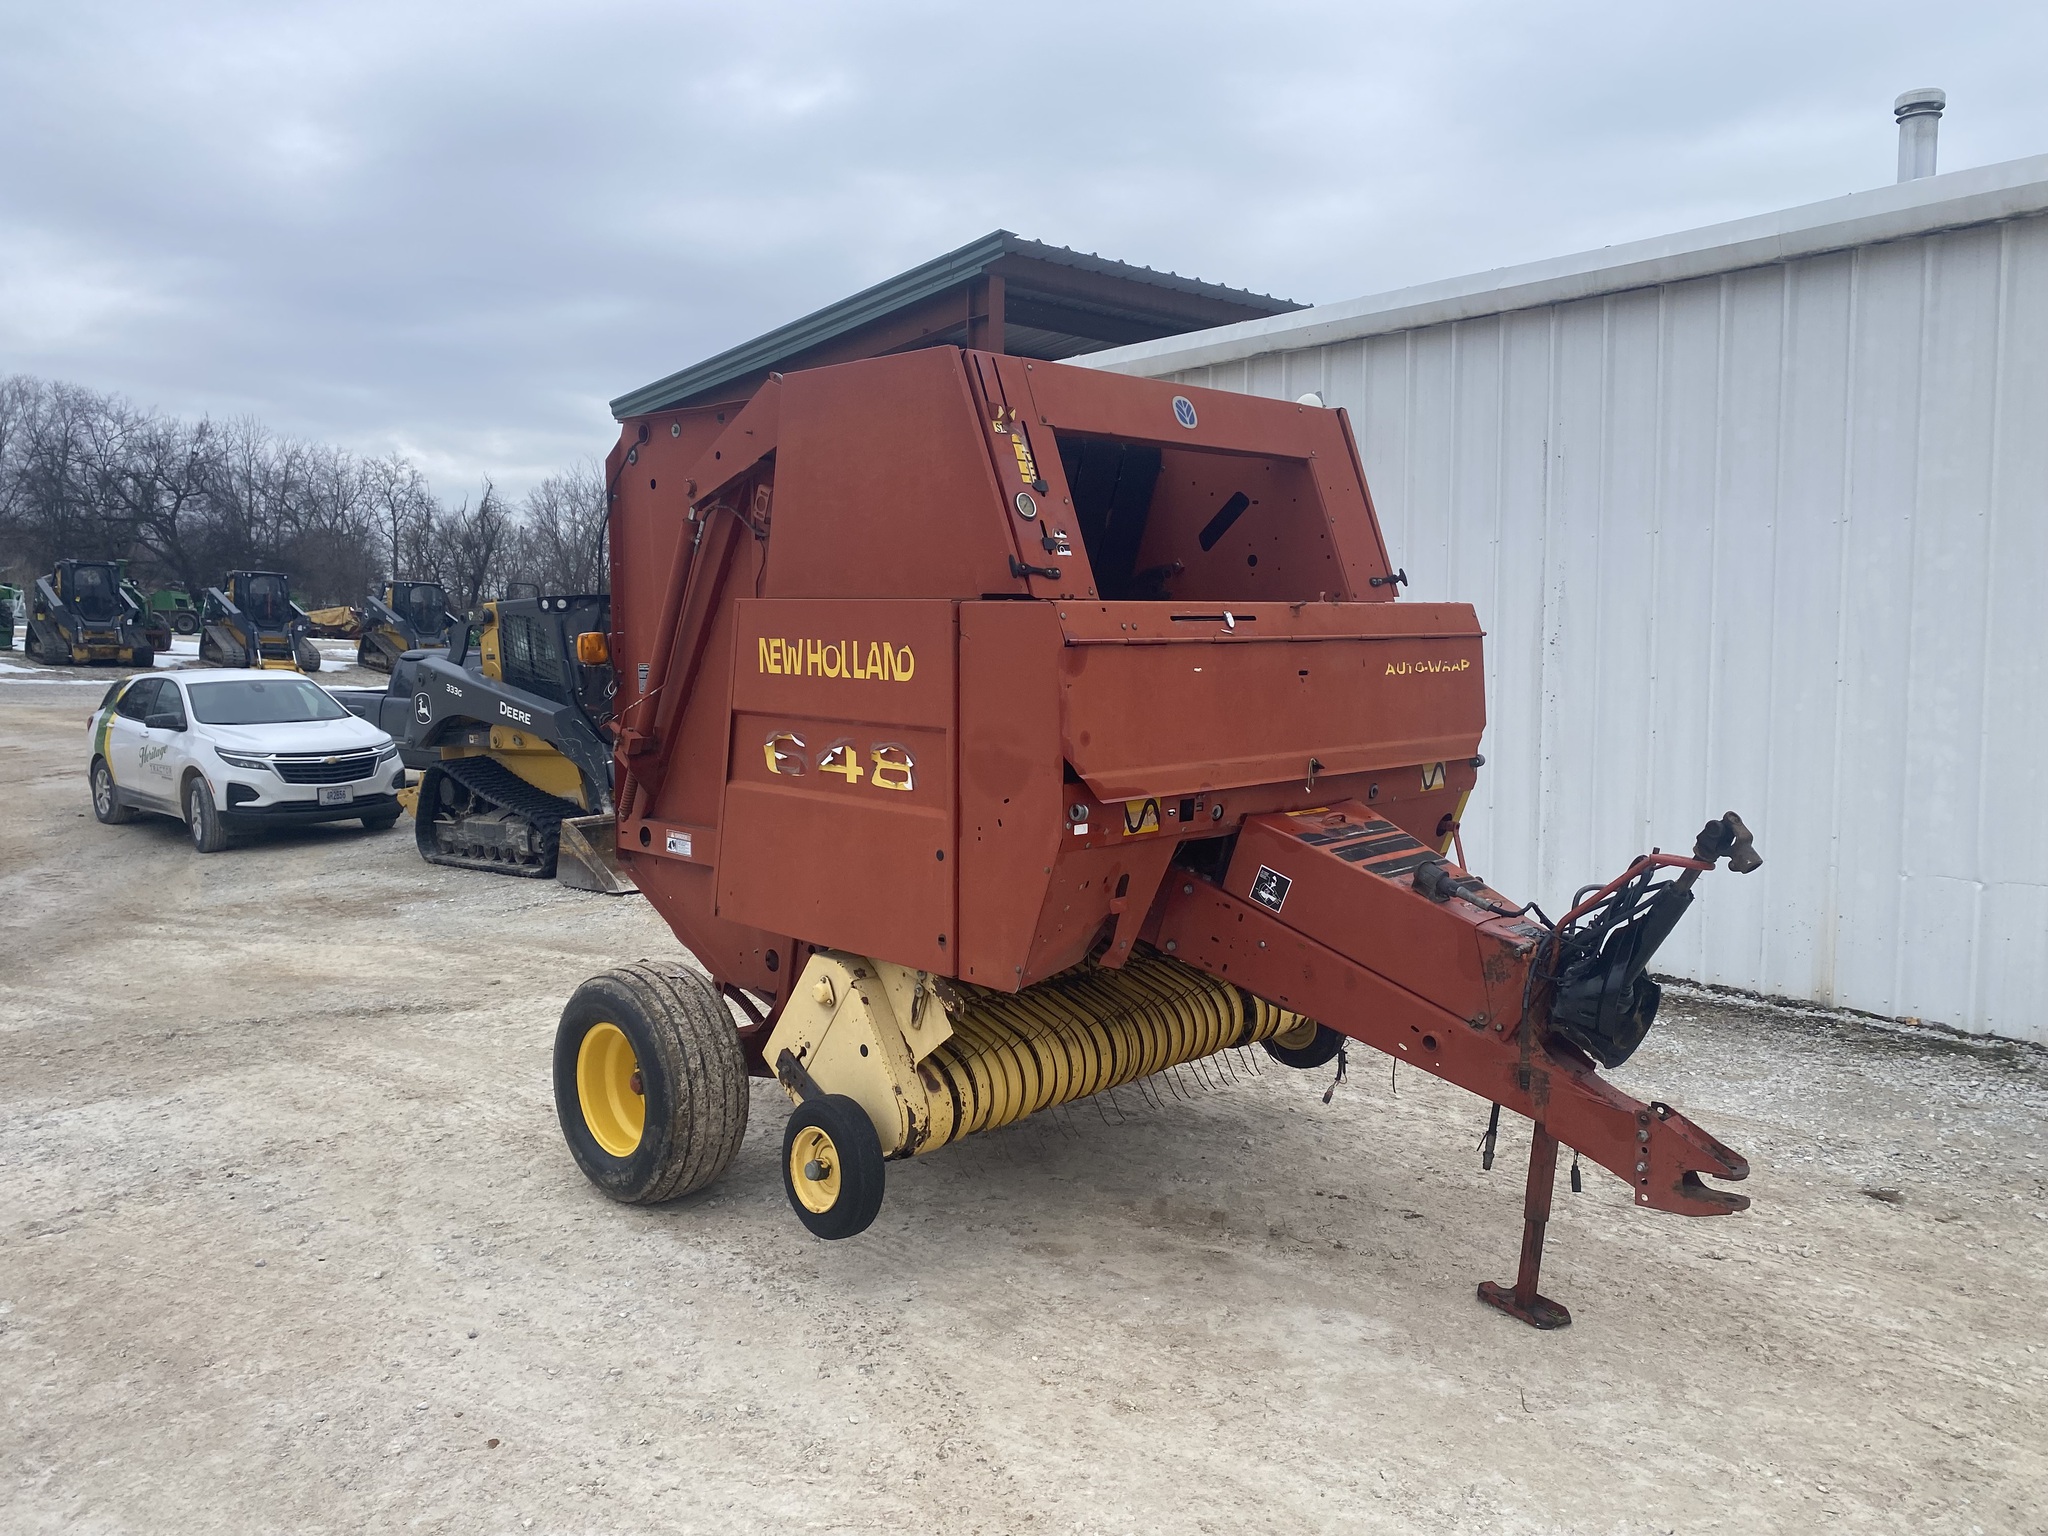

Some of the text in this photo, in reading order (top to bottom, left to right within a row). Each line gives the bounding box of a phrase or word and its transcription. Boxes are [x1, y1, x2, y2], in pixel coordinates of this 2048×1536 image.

[758, 637, 915, 682] NEW HOLLAND
[446, 683, 463, 698] 333G
[499, 701, 531, 725] DEERE
[139, 744, 168, 768] Heritage
[763, 732, 915, 791] 648
